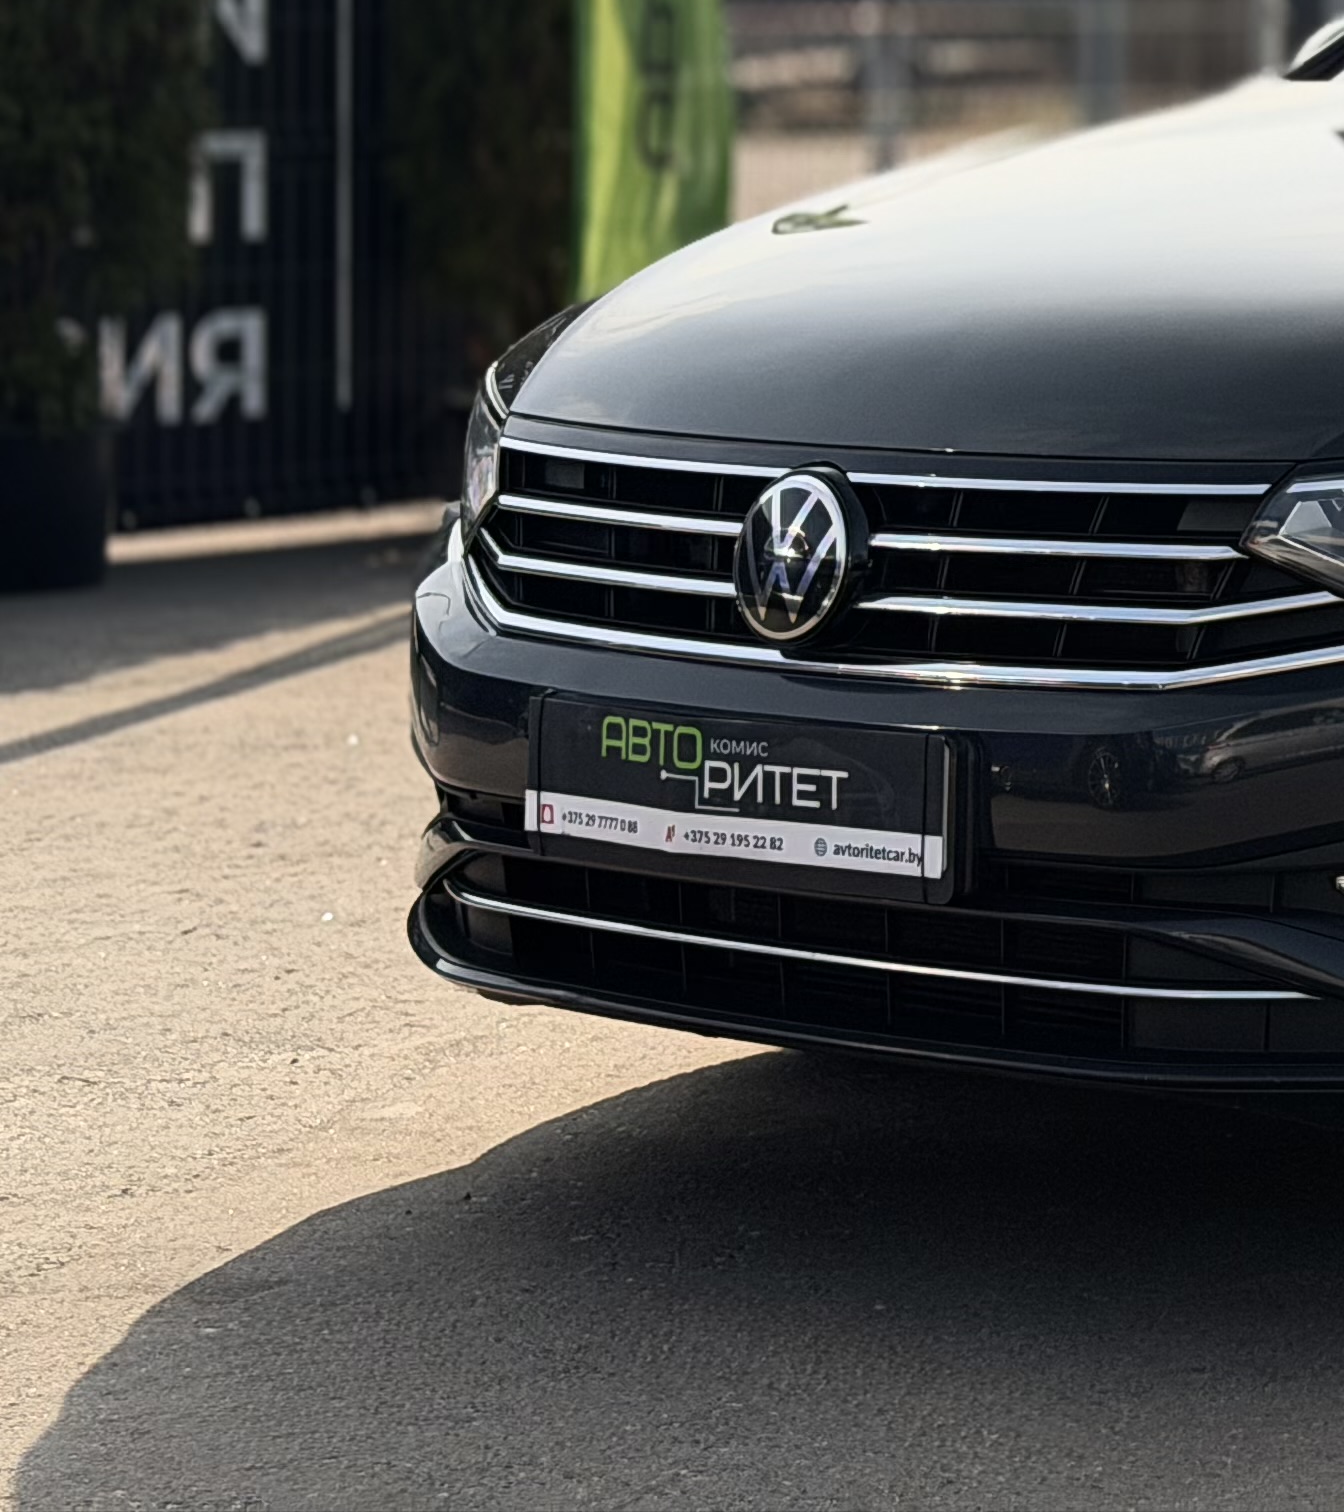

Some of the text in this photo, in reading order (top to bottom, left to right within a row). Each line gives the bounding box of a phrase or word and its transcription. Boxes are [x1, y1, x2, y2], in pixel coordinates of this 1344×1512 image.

[601, 715, 703, 769] АВТО
[709, 737, 769, 758] КОМИС
[703, 760, 849, 811] РИТЕТ
[683, 829, 784, 851] +375 29 195 22 82
[833, 842, 924, 868] avtoritetcar.by
